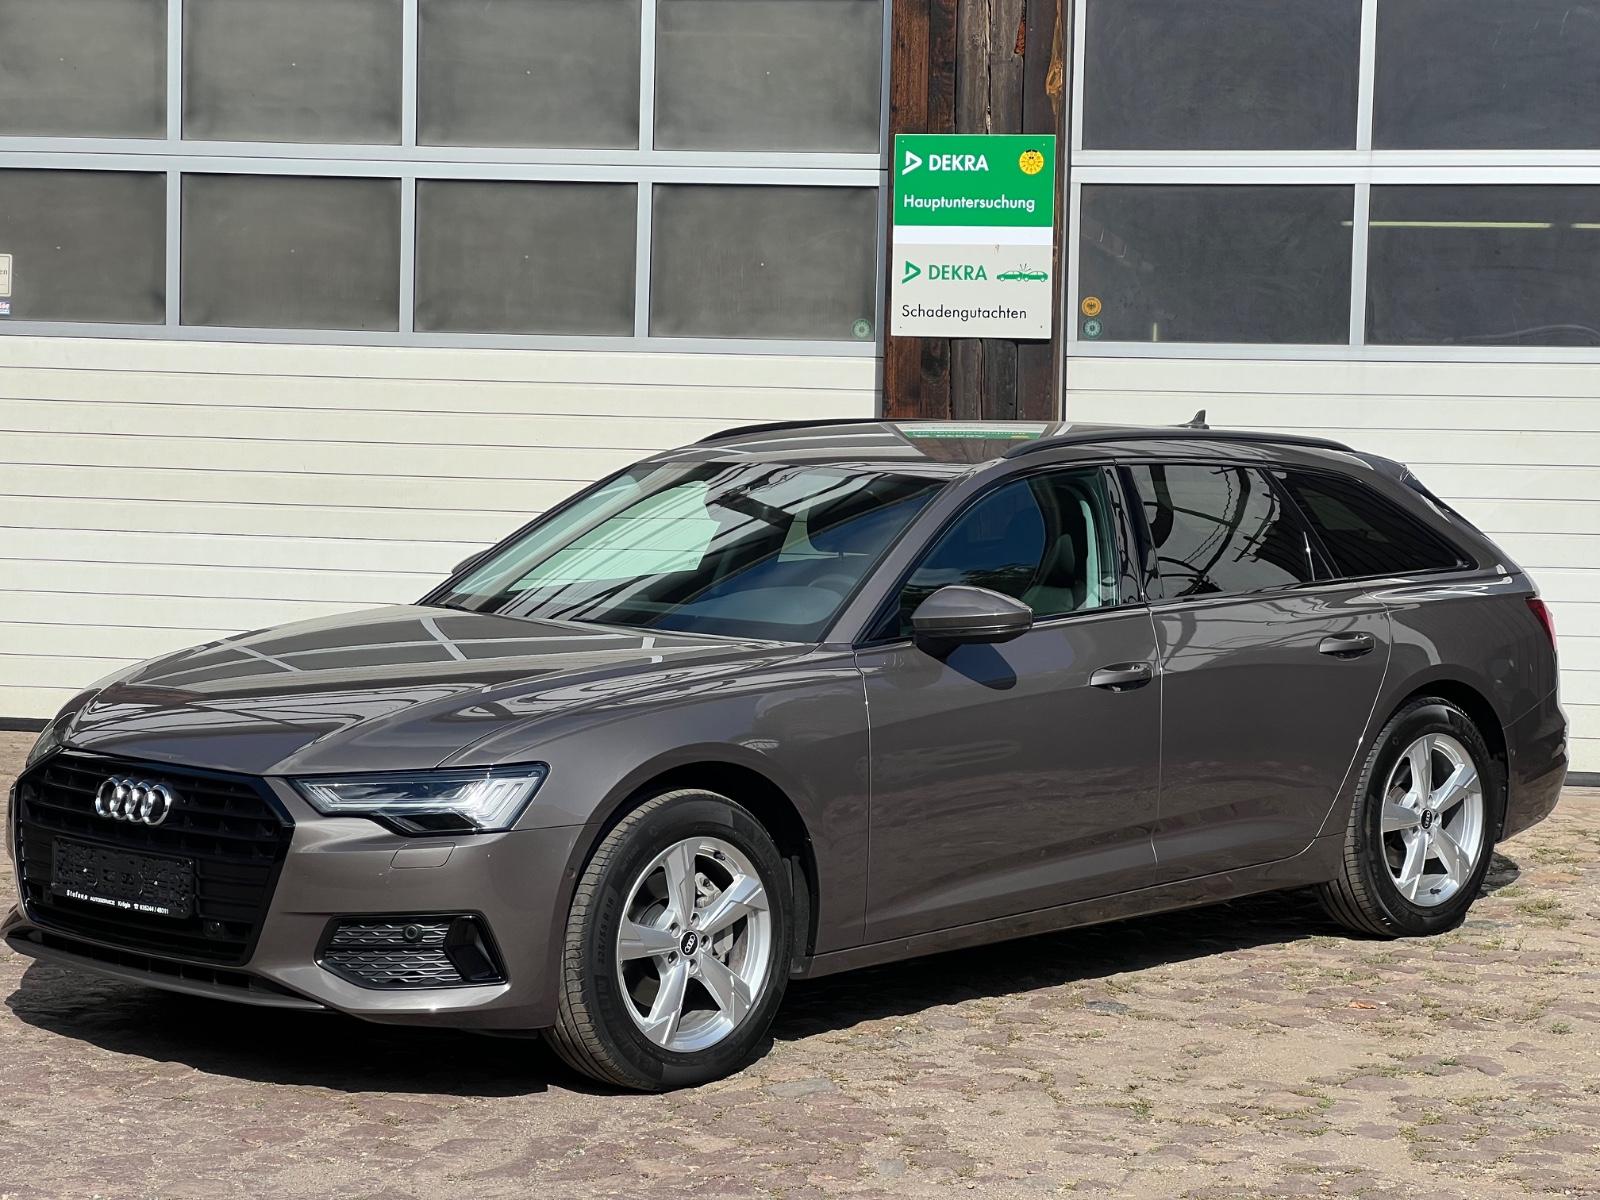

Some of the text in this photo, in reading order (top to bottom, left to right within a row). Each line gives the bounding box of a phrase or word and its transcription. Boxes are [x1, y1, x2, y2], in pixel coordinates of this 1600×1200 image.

[929, 154, 989, 172] DEKRA
[903, 194, 1036, 213] Hauptuntersuchung
[928, 264, 988, 281] DEKRA
[901, 304, 1028, 322] Schadengutachten
